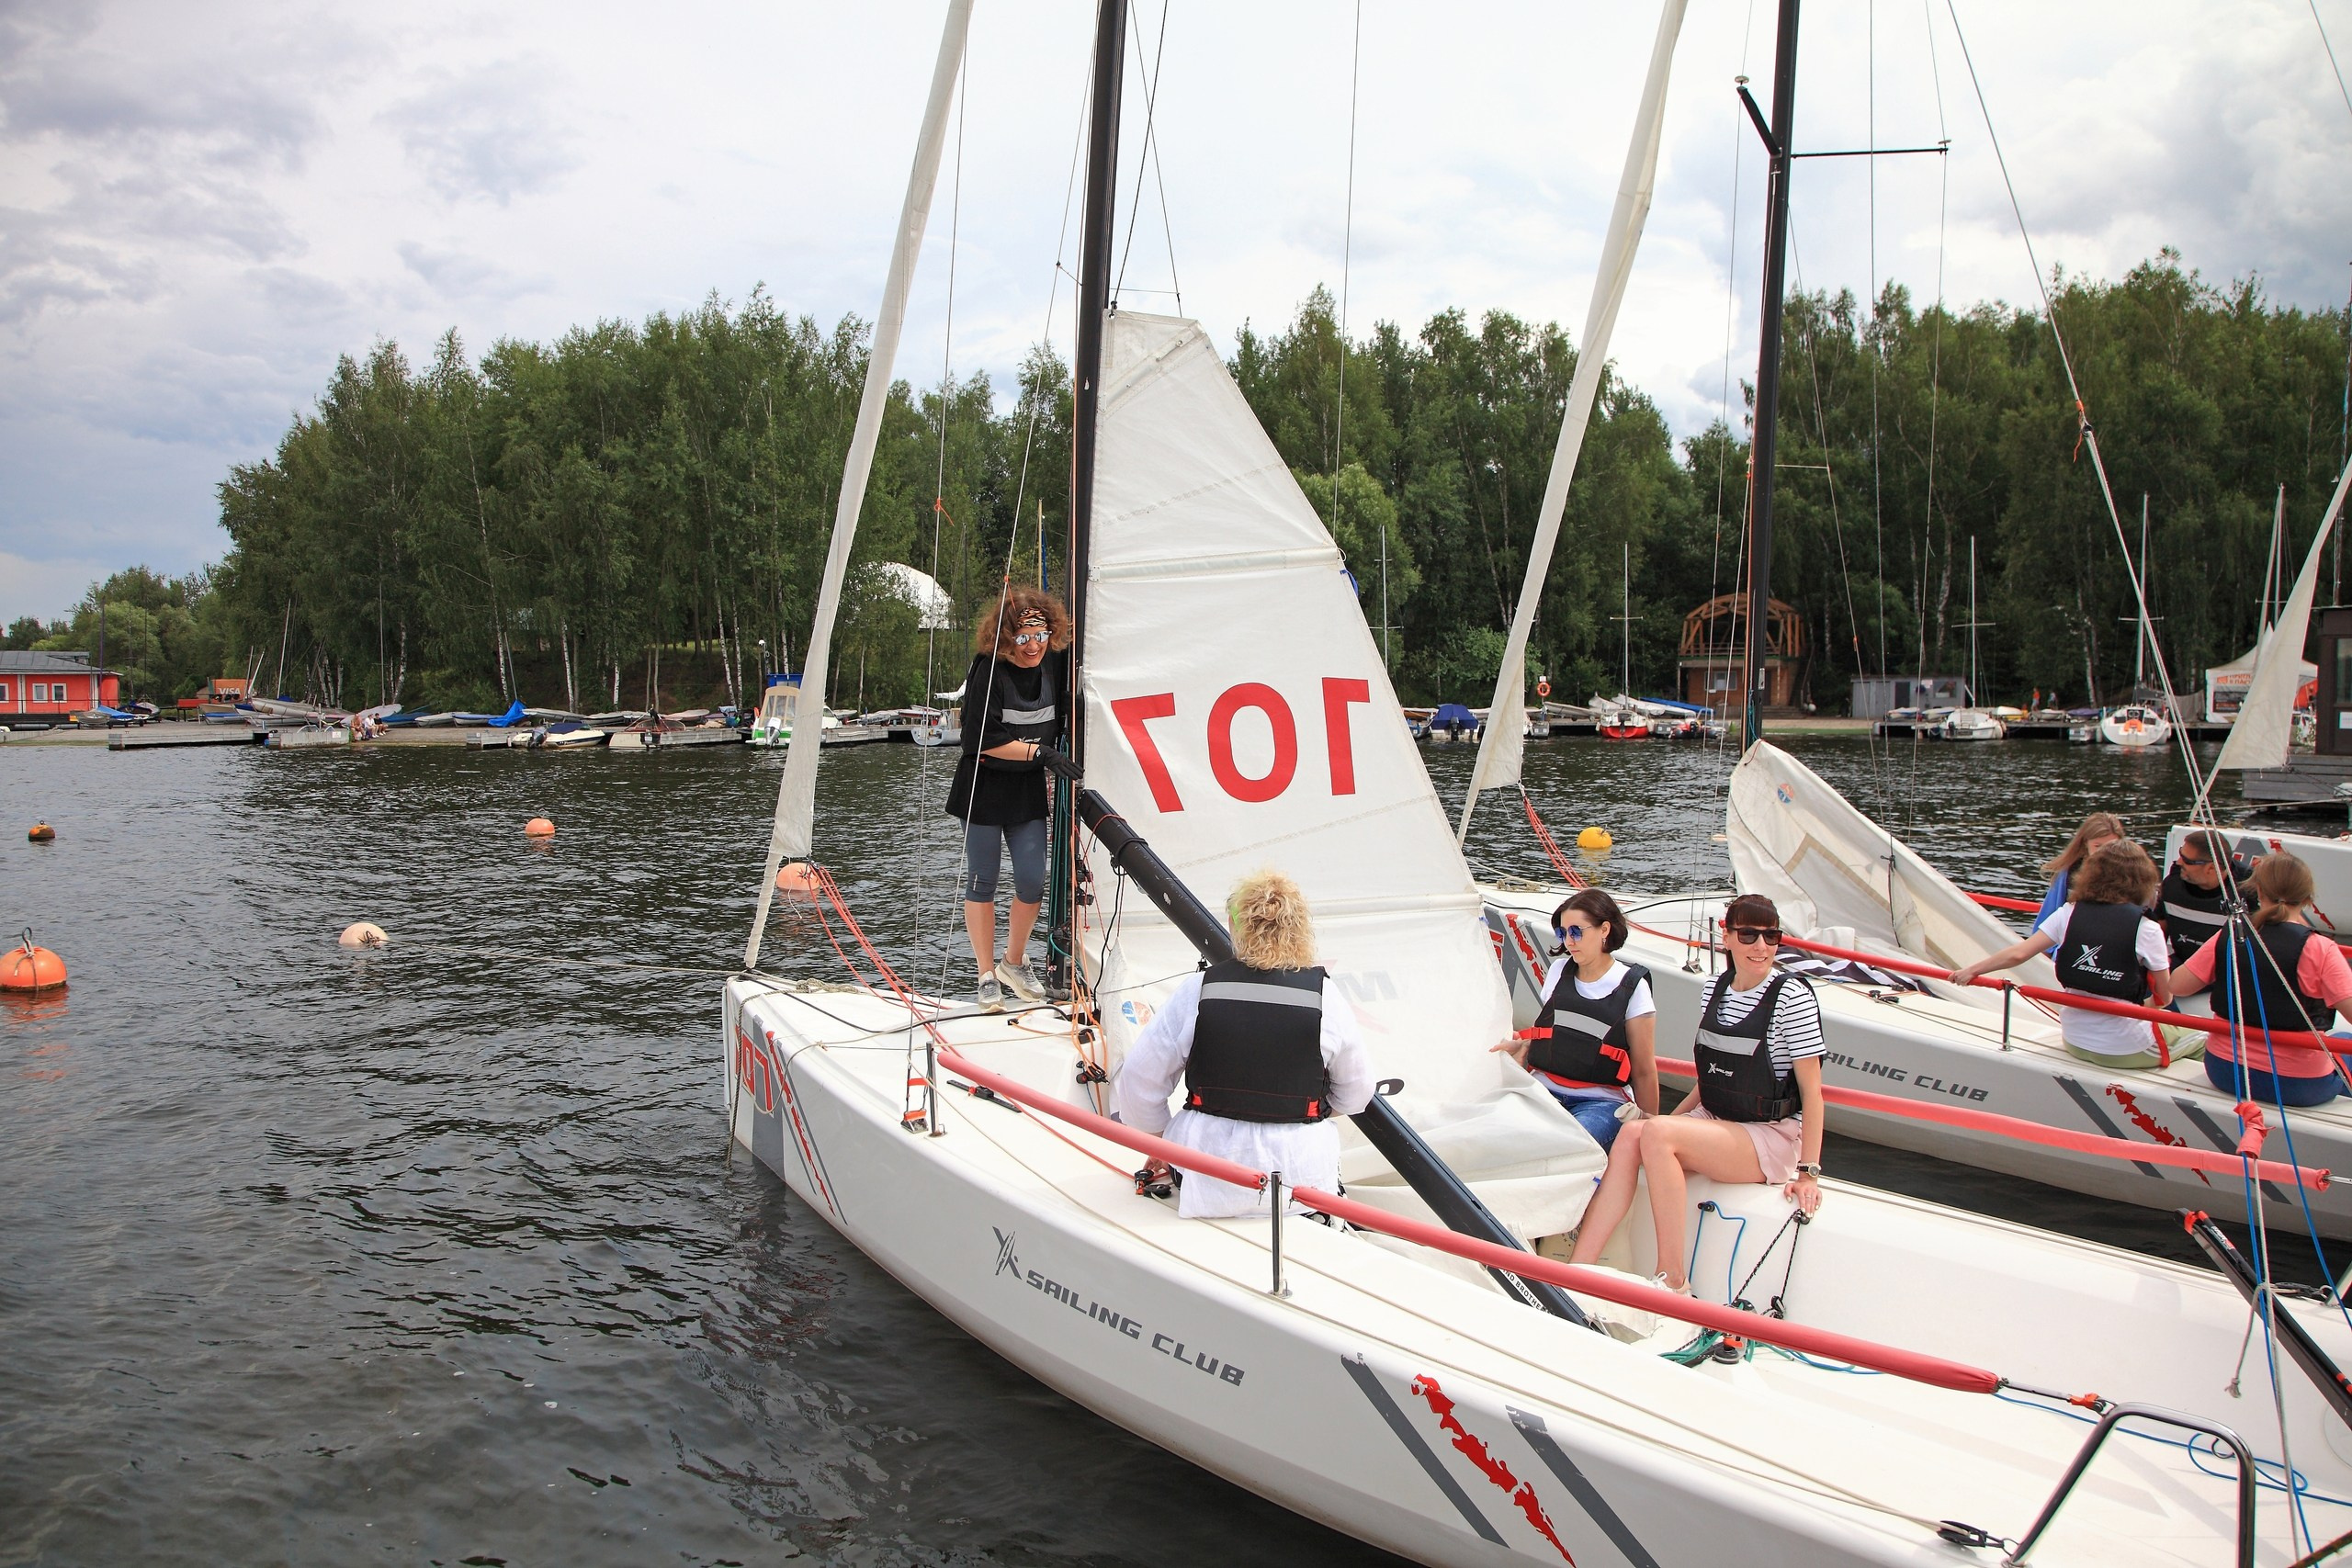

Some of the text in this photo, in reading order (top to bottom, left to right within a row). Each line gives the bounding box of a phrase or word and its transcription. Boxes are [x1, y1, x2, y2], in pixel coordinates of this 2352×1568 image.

[218, 687, 241, 695] VISA
[2077, 964, 2124, 977] SAILING
[1823, 1051, 1989, 1102] AILING CLUB
[1515, 1280, 1547, 1313] BROTHE
[1026, 1269, 1143, 1340] SAILING
[1151, 1333, 1246, 1387] CLUB
